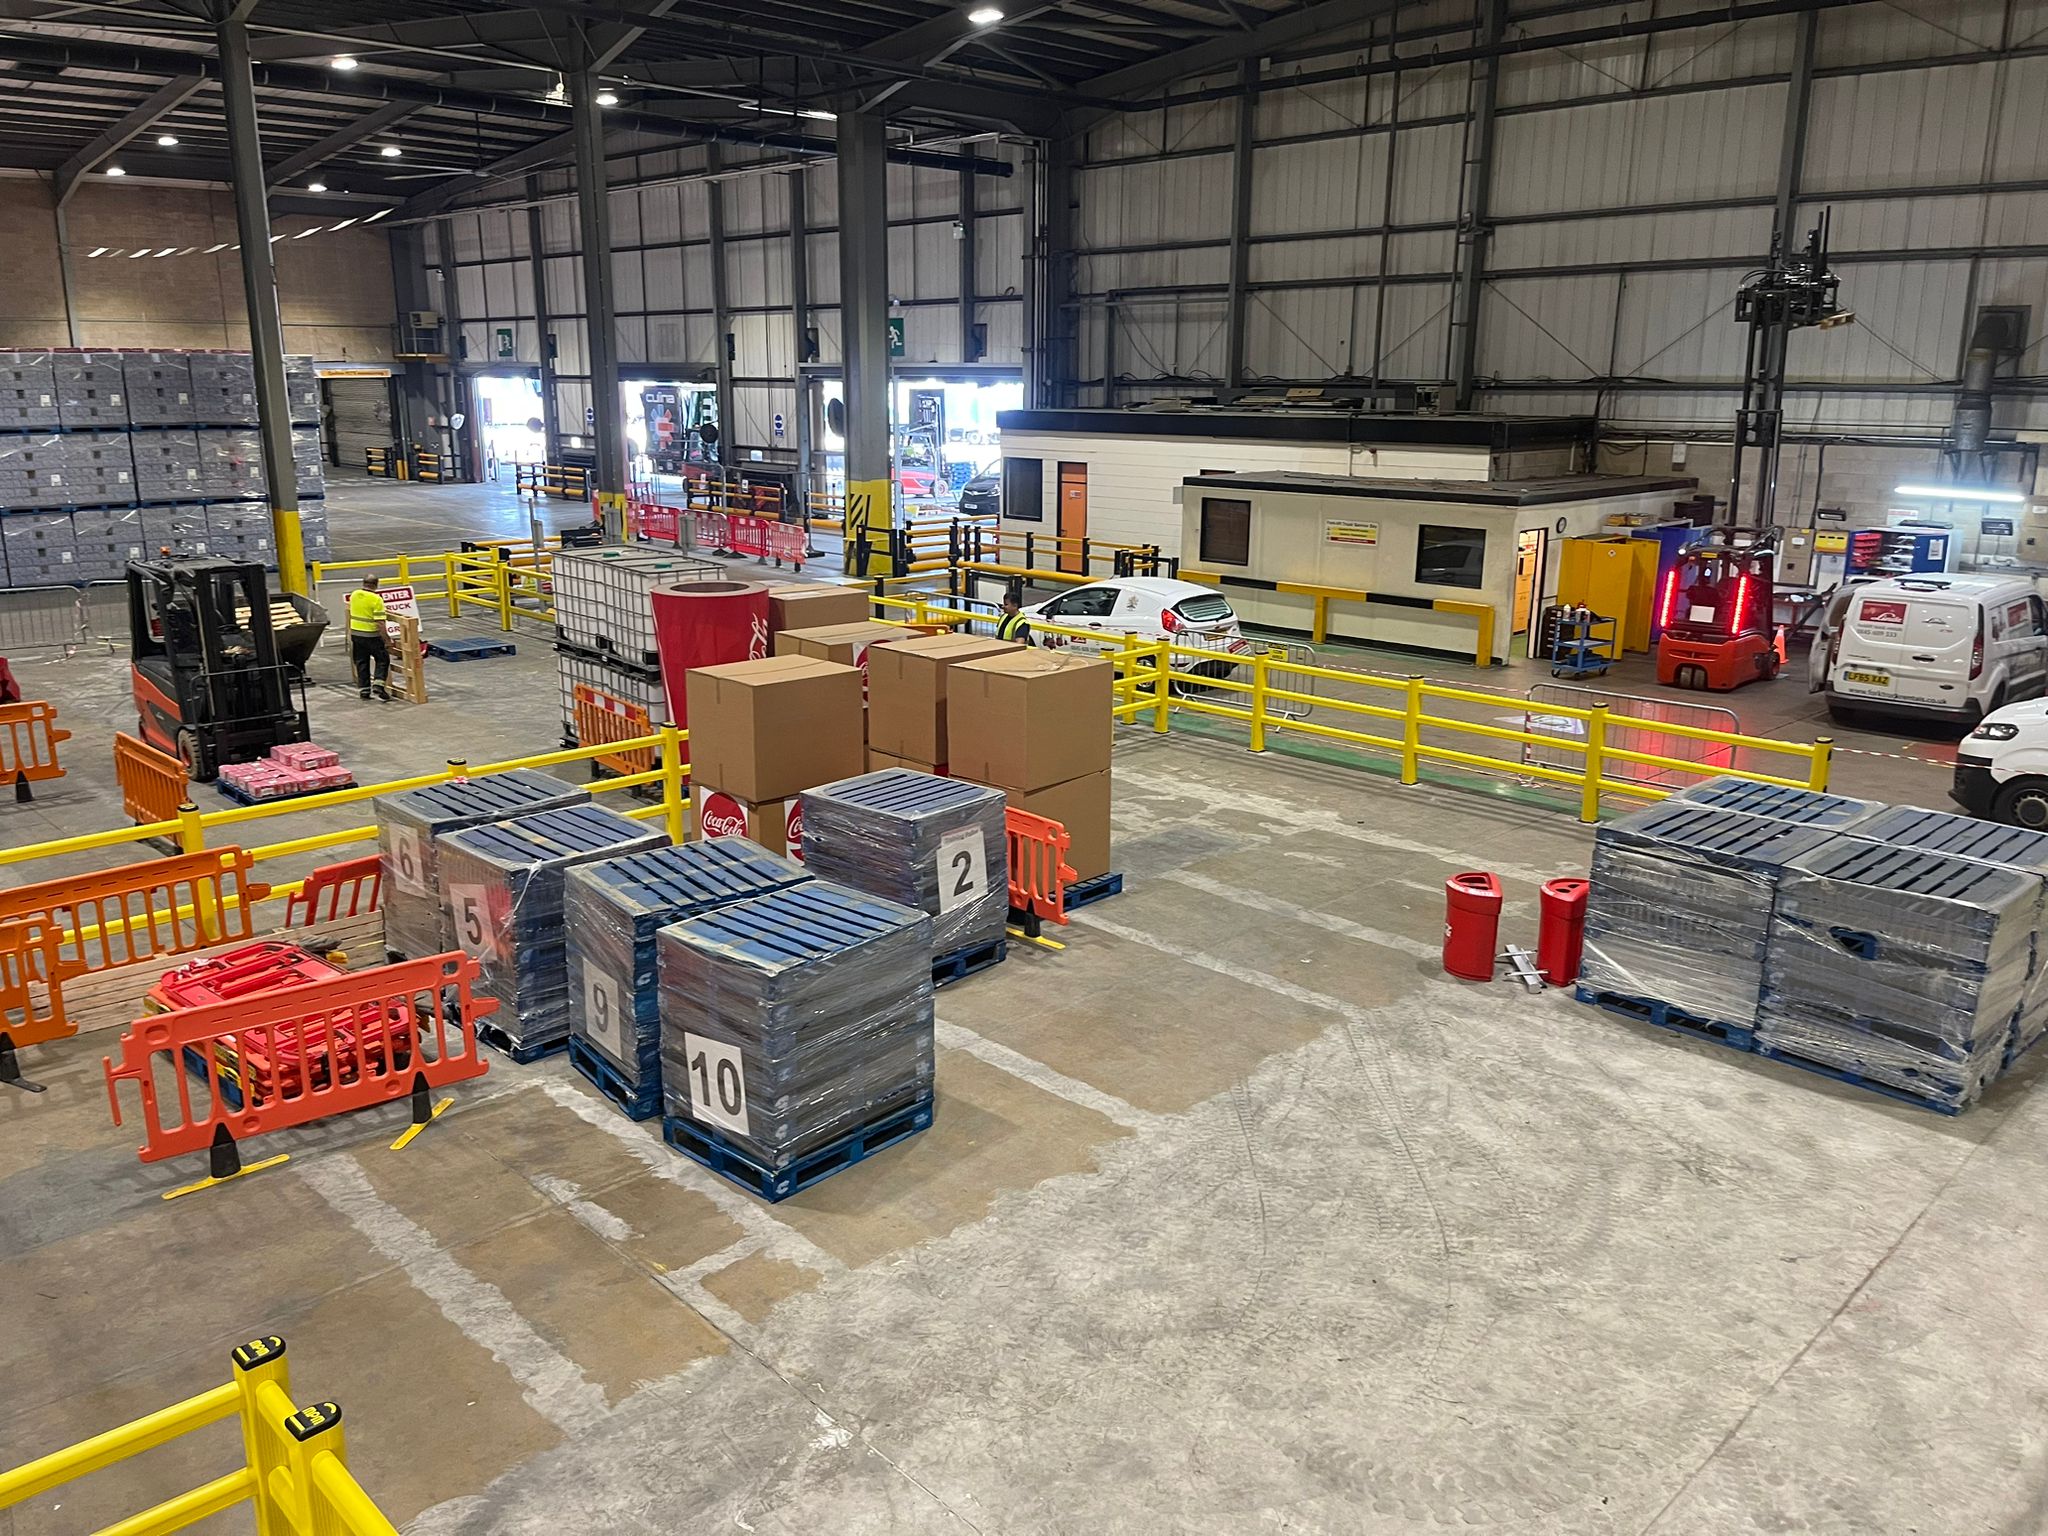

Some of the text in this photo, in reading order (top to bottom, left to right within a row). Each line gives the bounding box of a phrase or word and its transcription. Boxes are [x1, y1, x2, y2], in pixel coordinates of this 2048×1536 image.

[382, 590, 410, 600] ENTER
[385, 602, 412, 612] RUCK
[399, 837, 414, 881] 6
[951, 850, 974, 897] 2
[463, 897, 482, 946] 5
[593, 982, 609, 1033] 9
[691, 1050, 742, 1117] 10
